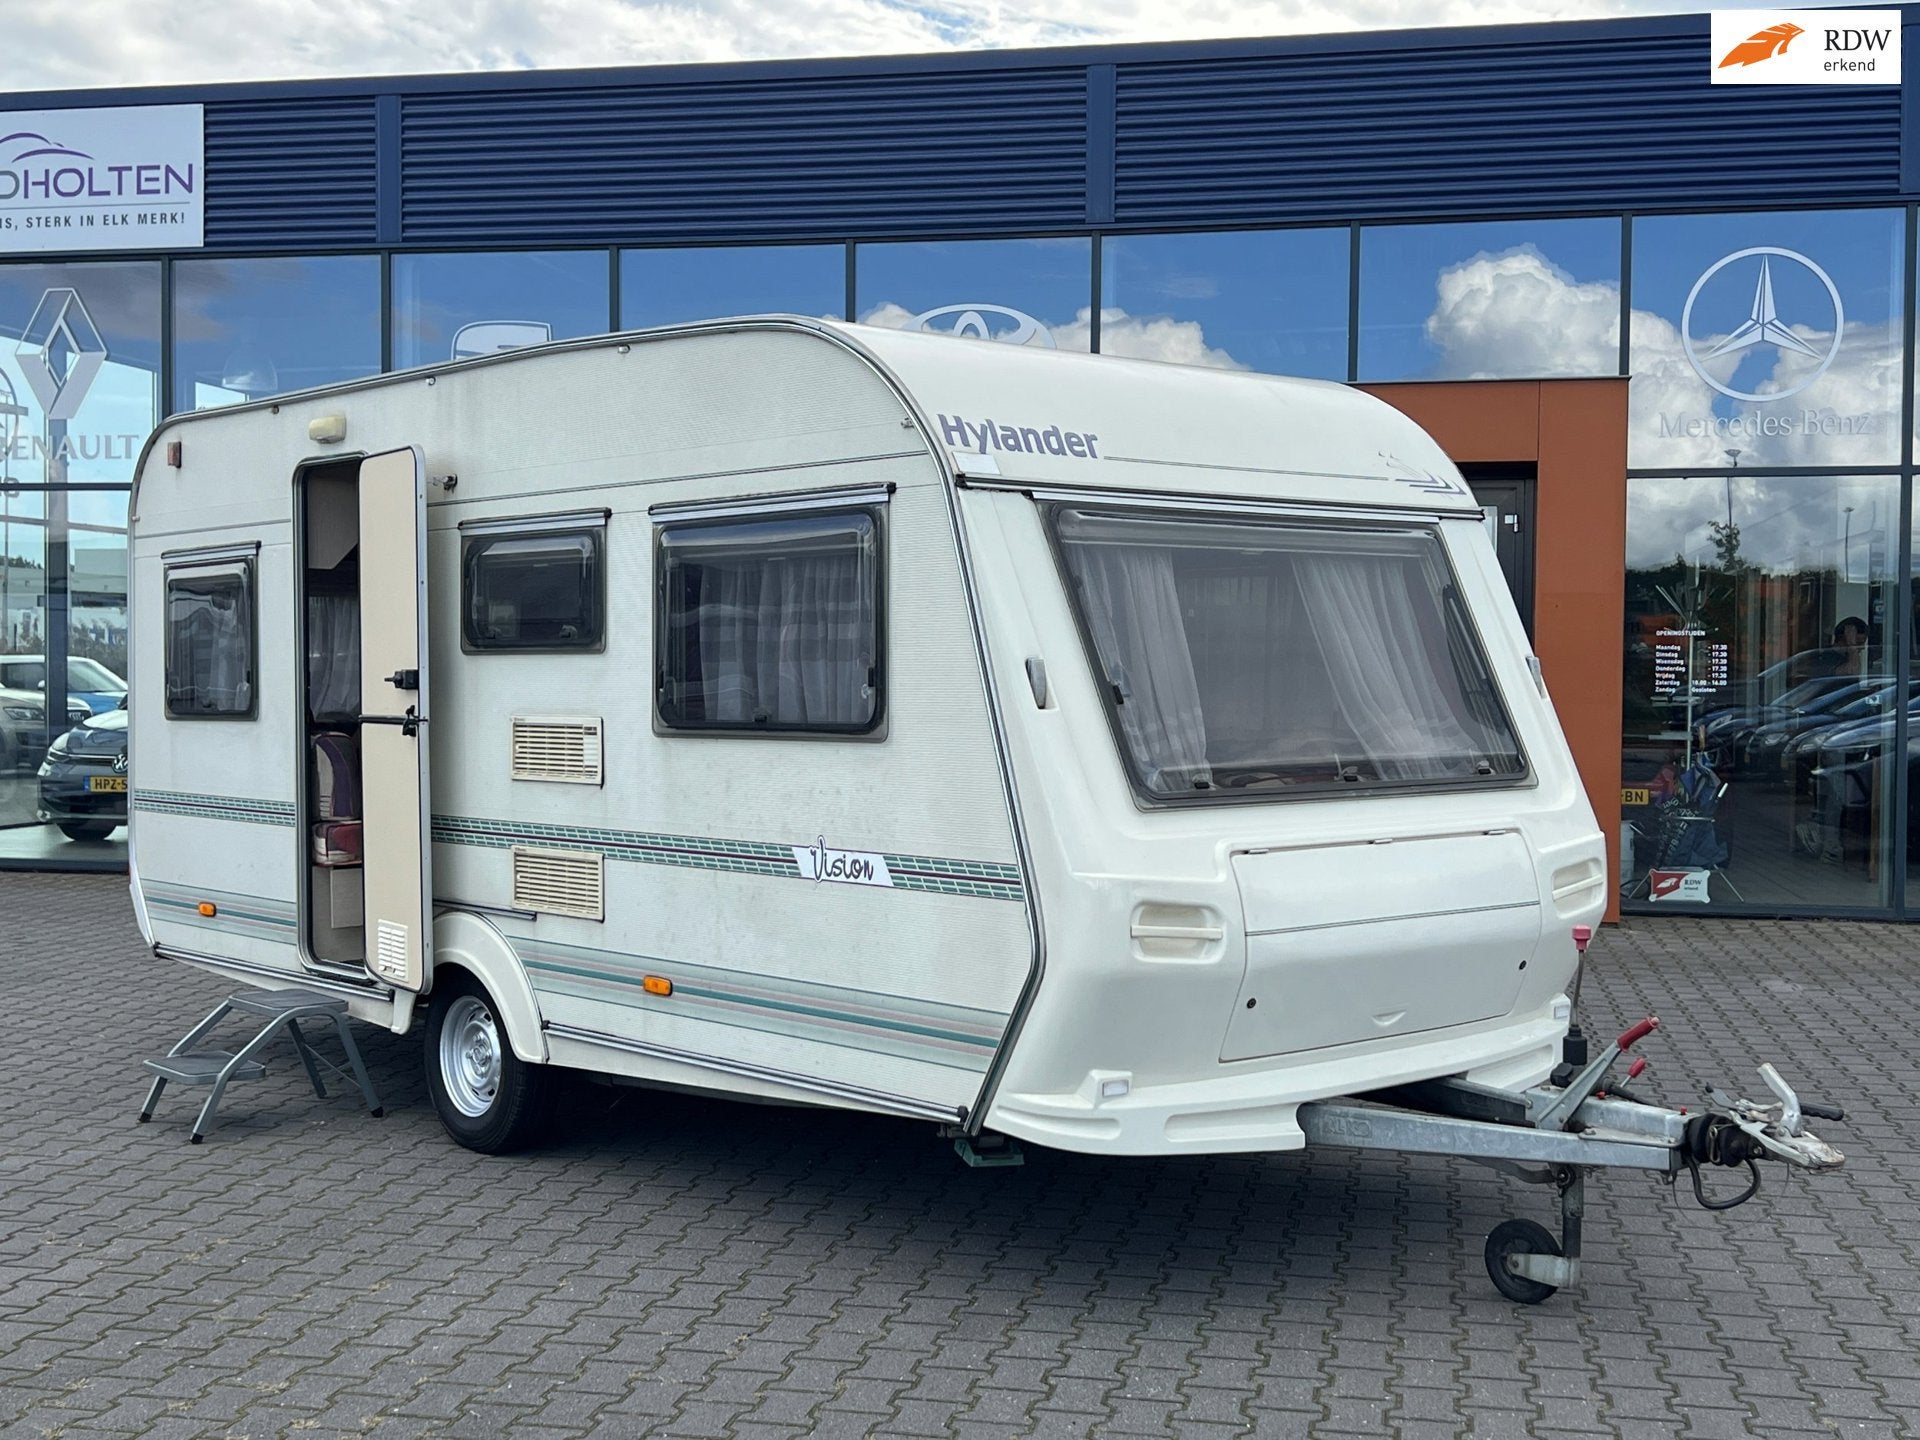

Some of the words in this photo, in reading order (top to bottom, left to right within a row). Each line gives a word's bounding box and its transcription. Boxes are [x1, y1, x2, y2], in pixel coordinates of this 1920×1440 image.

[26, 215, 72, 229] STERK
[80, 214, 95, 227] IN
[103, 213, 130, 226] ELK
[137, 212, 186, 225] MERK!
[936, 413, 1098, 459] Hylander
[810, 839, 874, 881] Vision
